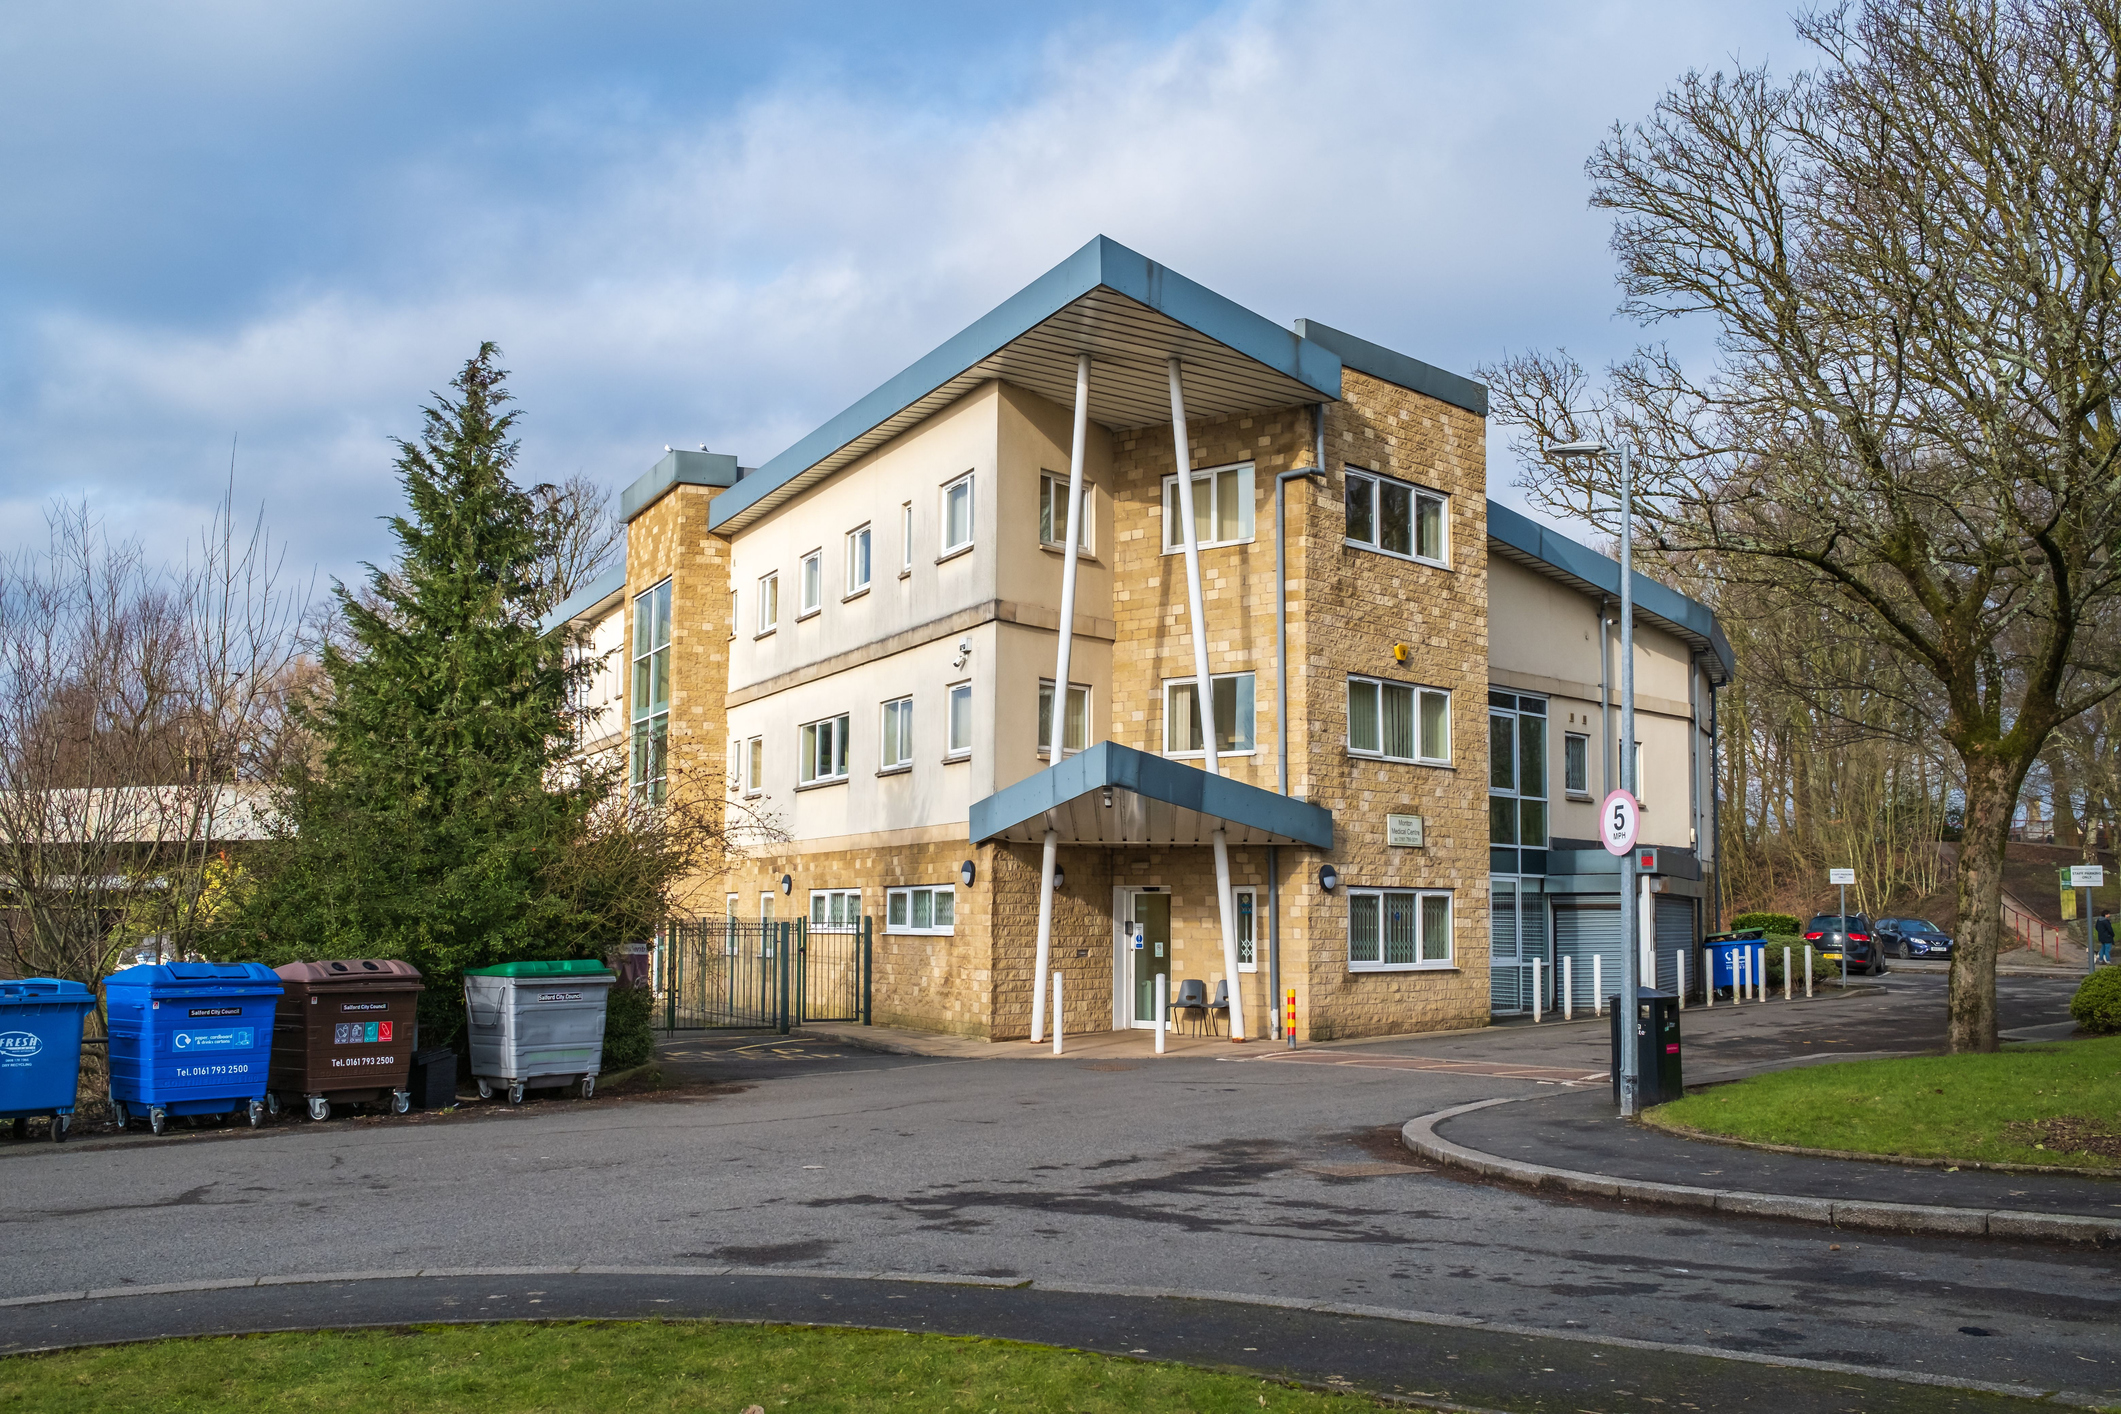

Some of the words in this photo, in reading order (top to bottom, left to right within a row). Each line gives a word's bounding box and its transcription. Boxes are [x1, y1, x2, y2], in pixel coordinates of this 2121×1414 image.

[1613, 804, 1625, 831] 5
[1391, 827, 1406, 835] Medical
[1406, 828, 1420, 836] Centre
[1613, 831, 1626, 840] MPH
[0, 1037, 37, 1047] FRESH
[331, 1059, 345, 1067] Tel.
[345, 1058, 360, 1067] 0161
[361, 1057, 375, 1066] 793
[376, 1056, 394, 1065] 2500
[177, 1068, 191, 1077] Tel.
[192, 1067, 209, 1076] 0161
[211, 1065, 226, 1075] 793
[228, 1064, 248, 1074] 2500
